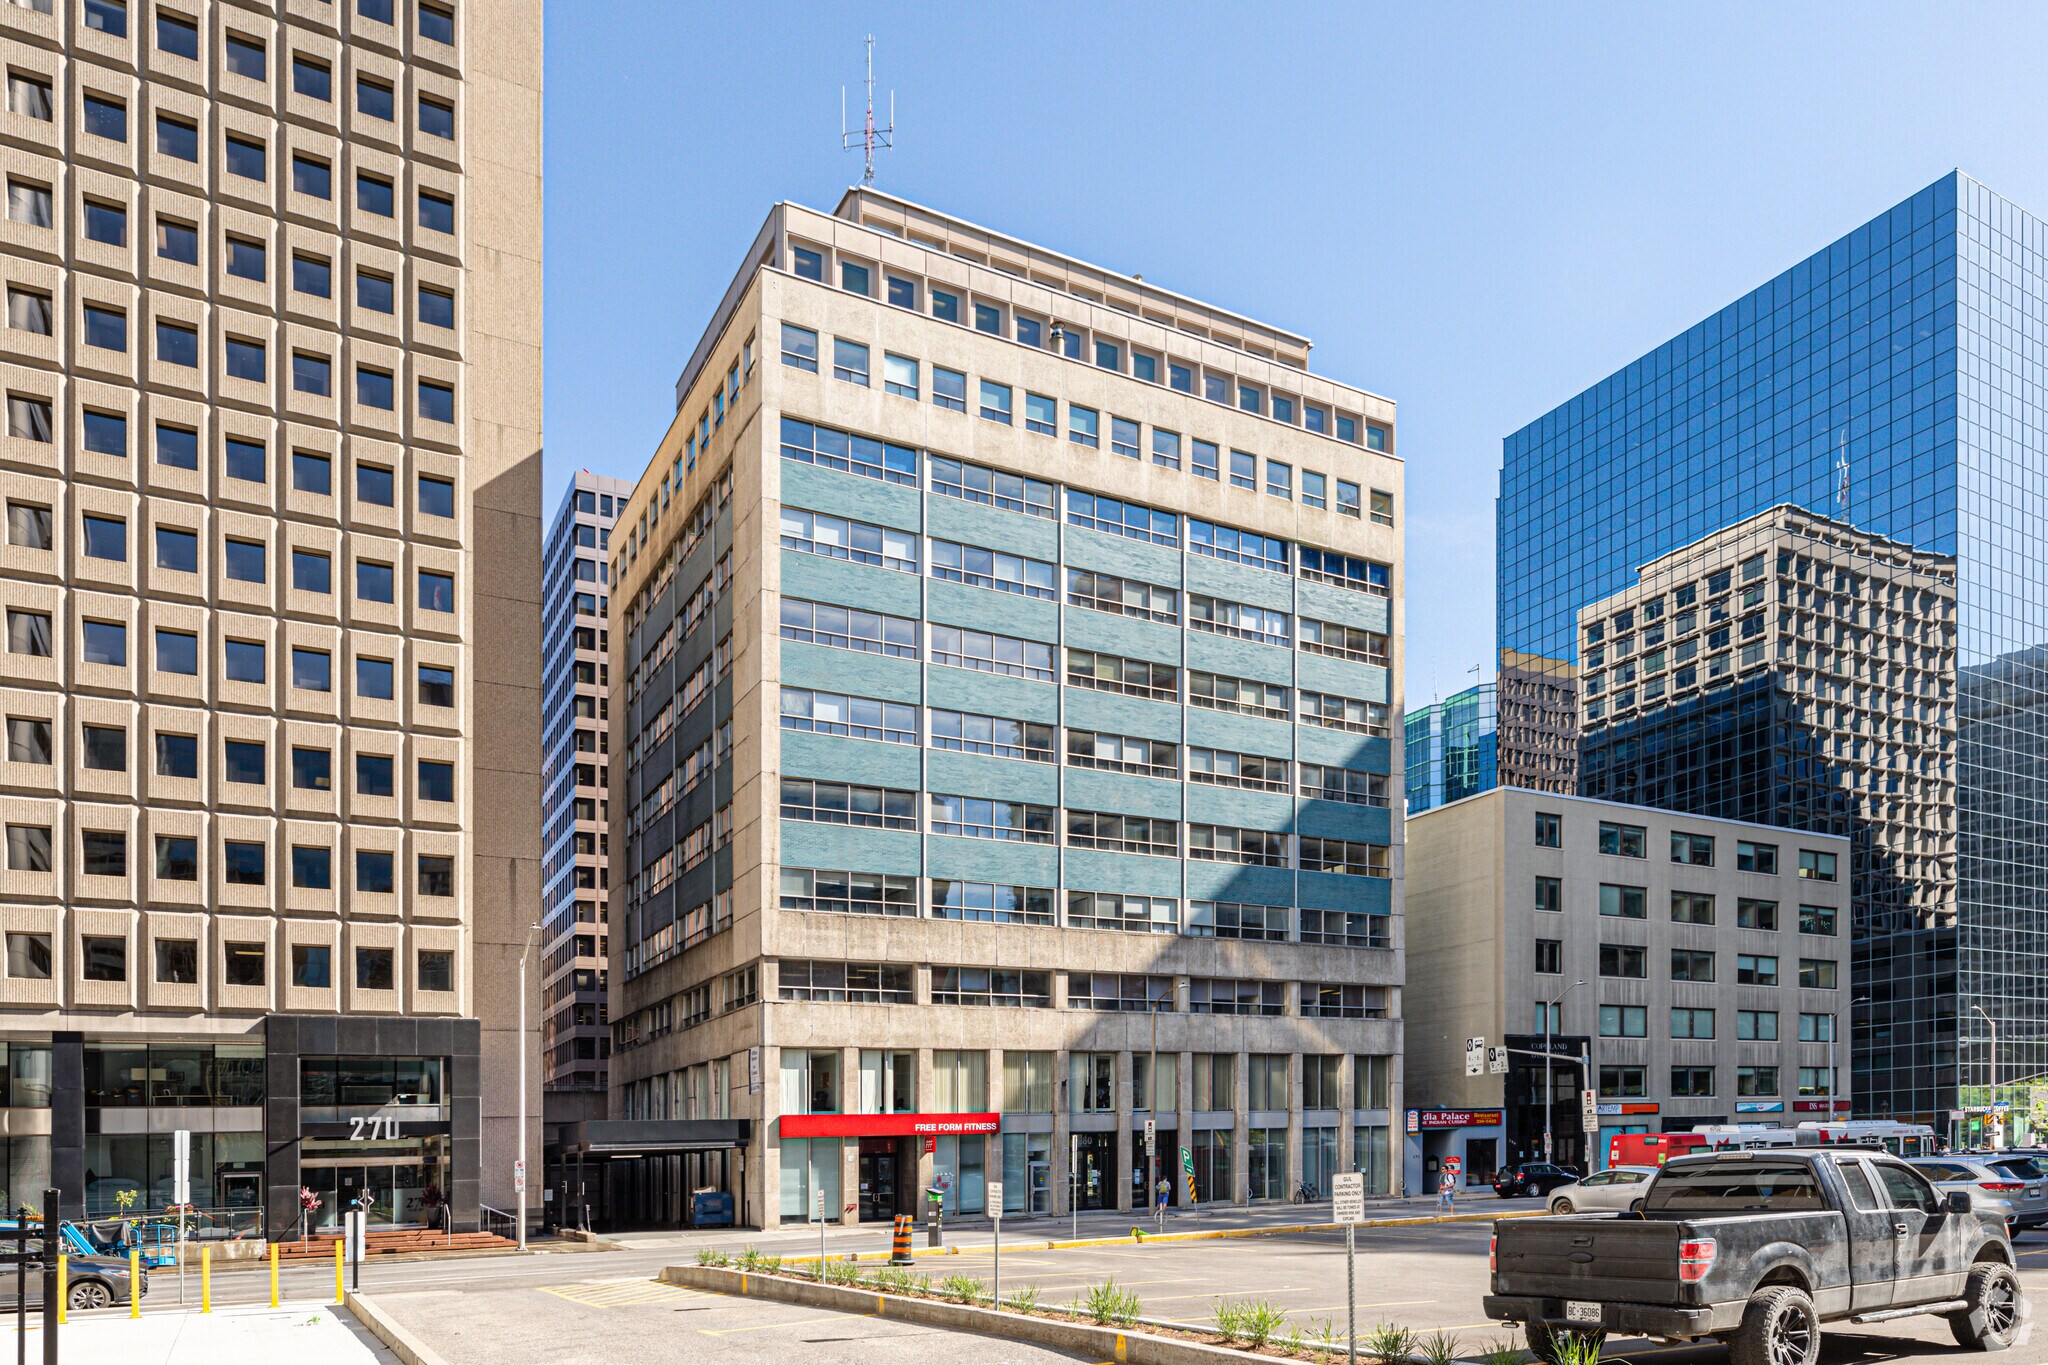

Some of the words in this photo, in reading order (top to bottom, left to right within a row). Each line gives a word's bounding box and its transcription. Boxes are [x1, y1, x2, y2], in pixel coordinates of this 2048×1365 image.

[1422, 1112, 1437, 1121] dia
[1441, 1112, 1470, 1121] Palace
[350, 1116, 399, 1141] 270
[915, 1123, 936, 1132] FREE
[938, 1123, 962, 1131] FORM
[964, 1122, 997, 1131] FITNESS
[1580, 1307, 1600, 1317] 36086
